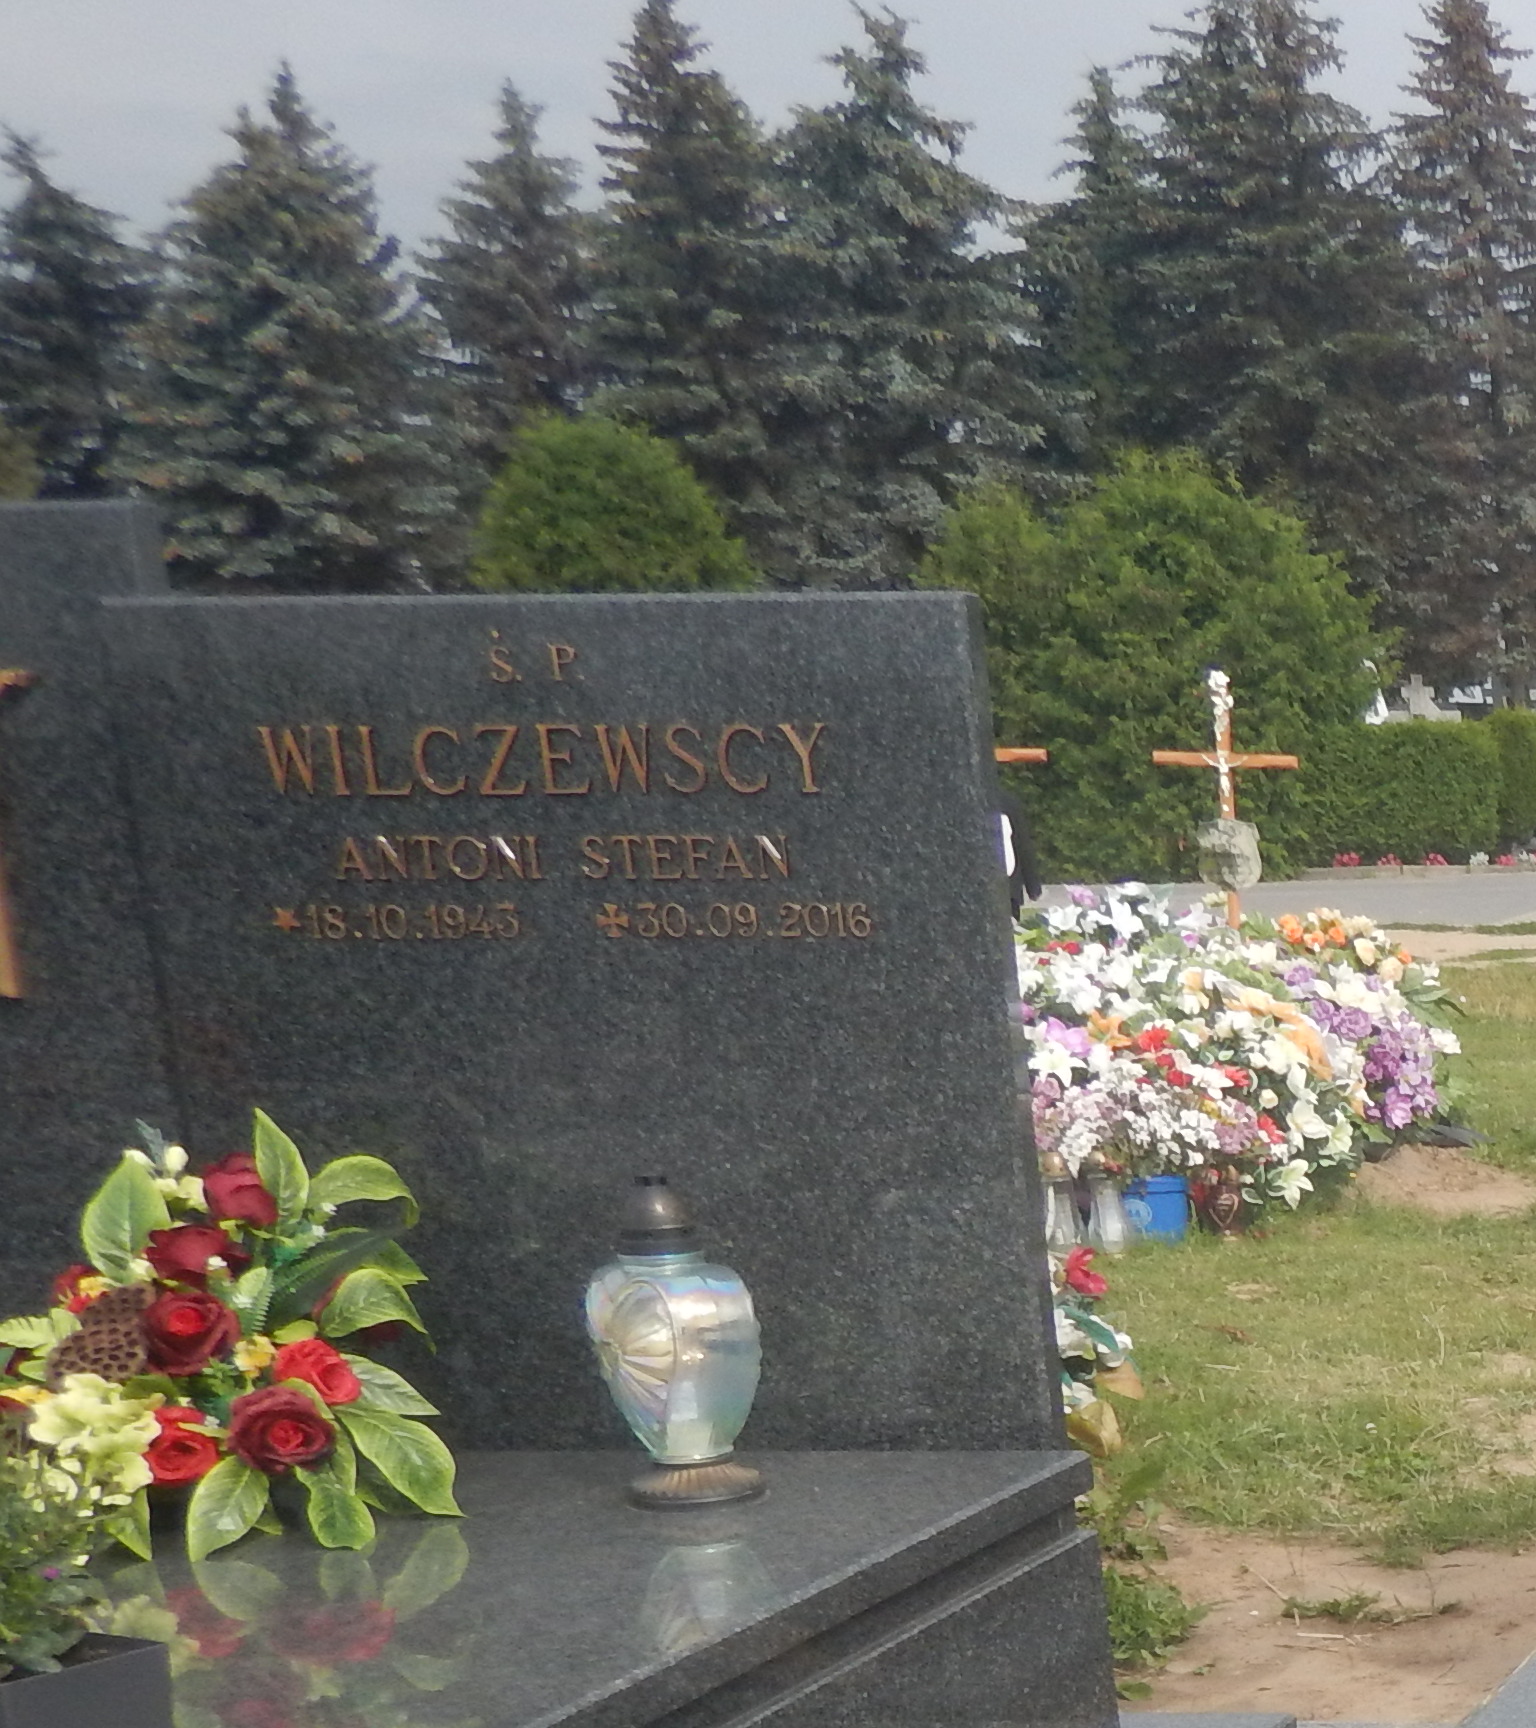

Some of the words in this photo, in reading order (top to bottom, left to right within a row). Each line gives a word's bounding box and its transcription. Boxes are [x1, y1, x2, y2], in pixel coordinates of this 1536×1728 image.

[256, 722, 827, 797] WILCZEWSCY
[335, 834, 543, 881] ANTONI
[580, 833, 791, 880] STEFAN
[637, 902, 873, 938] 30.09.2016
